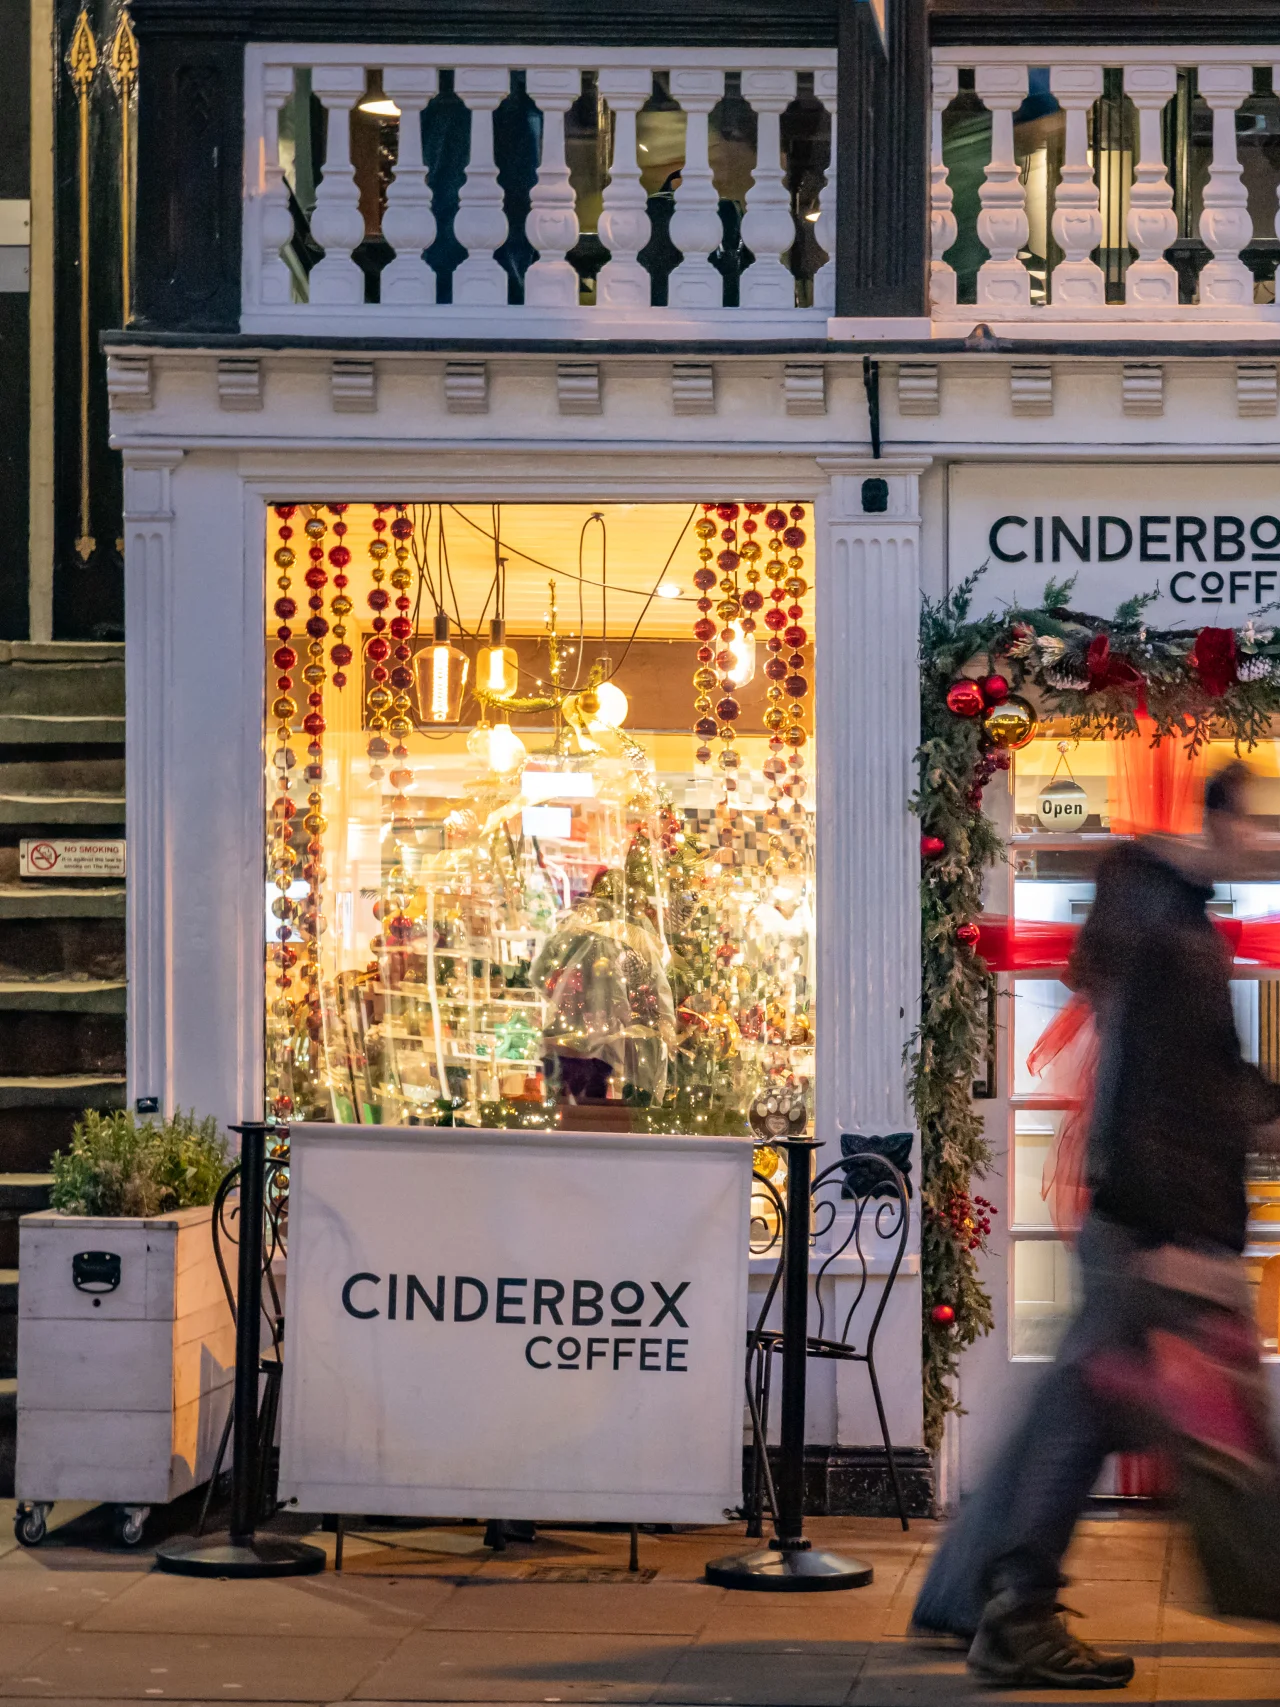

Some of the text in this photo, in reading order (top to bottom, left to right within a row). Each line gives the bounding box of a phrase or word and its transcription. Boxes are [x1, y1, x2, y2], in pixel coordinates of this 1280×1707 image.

[1042, 800, 1083, 818] Open
[341, 1272, 691, 1328] CINDERBOX
[524, 1335, 689, 1372] COFFEE
